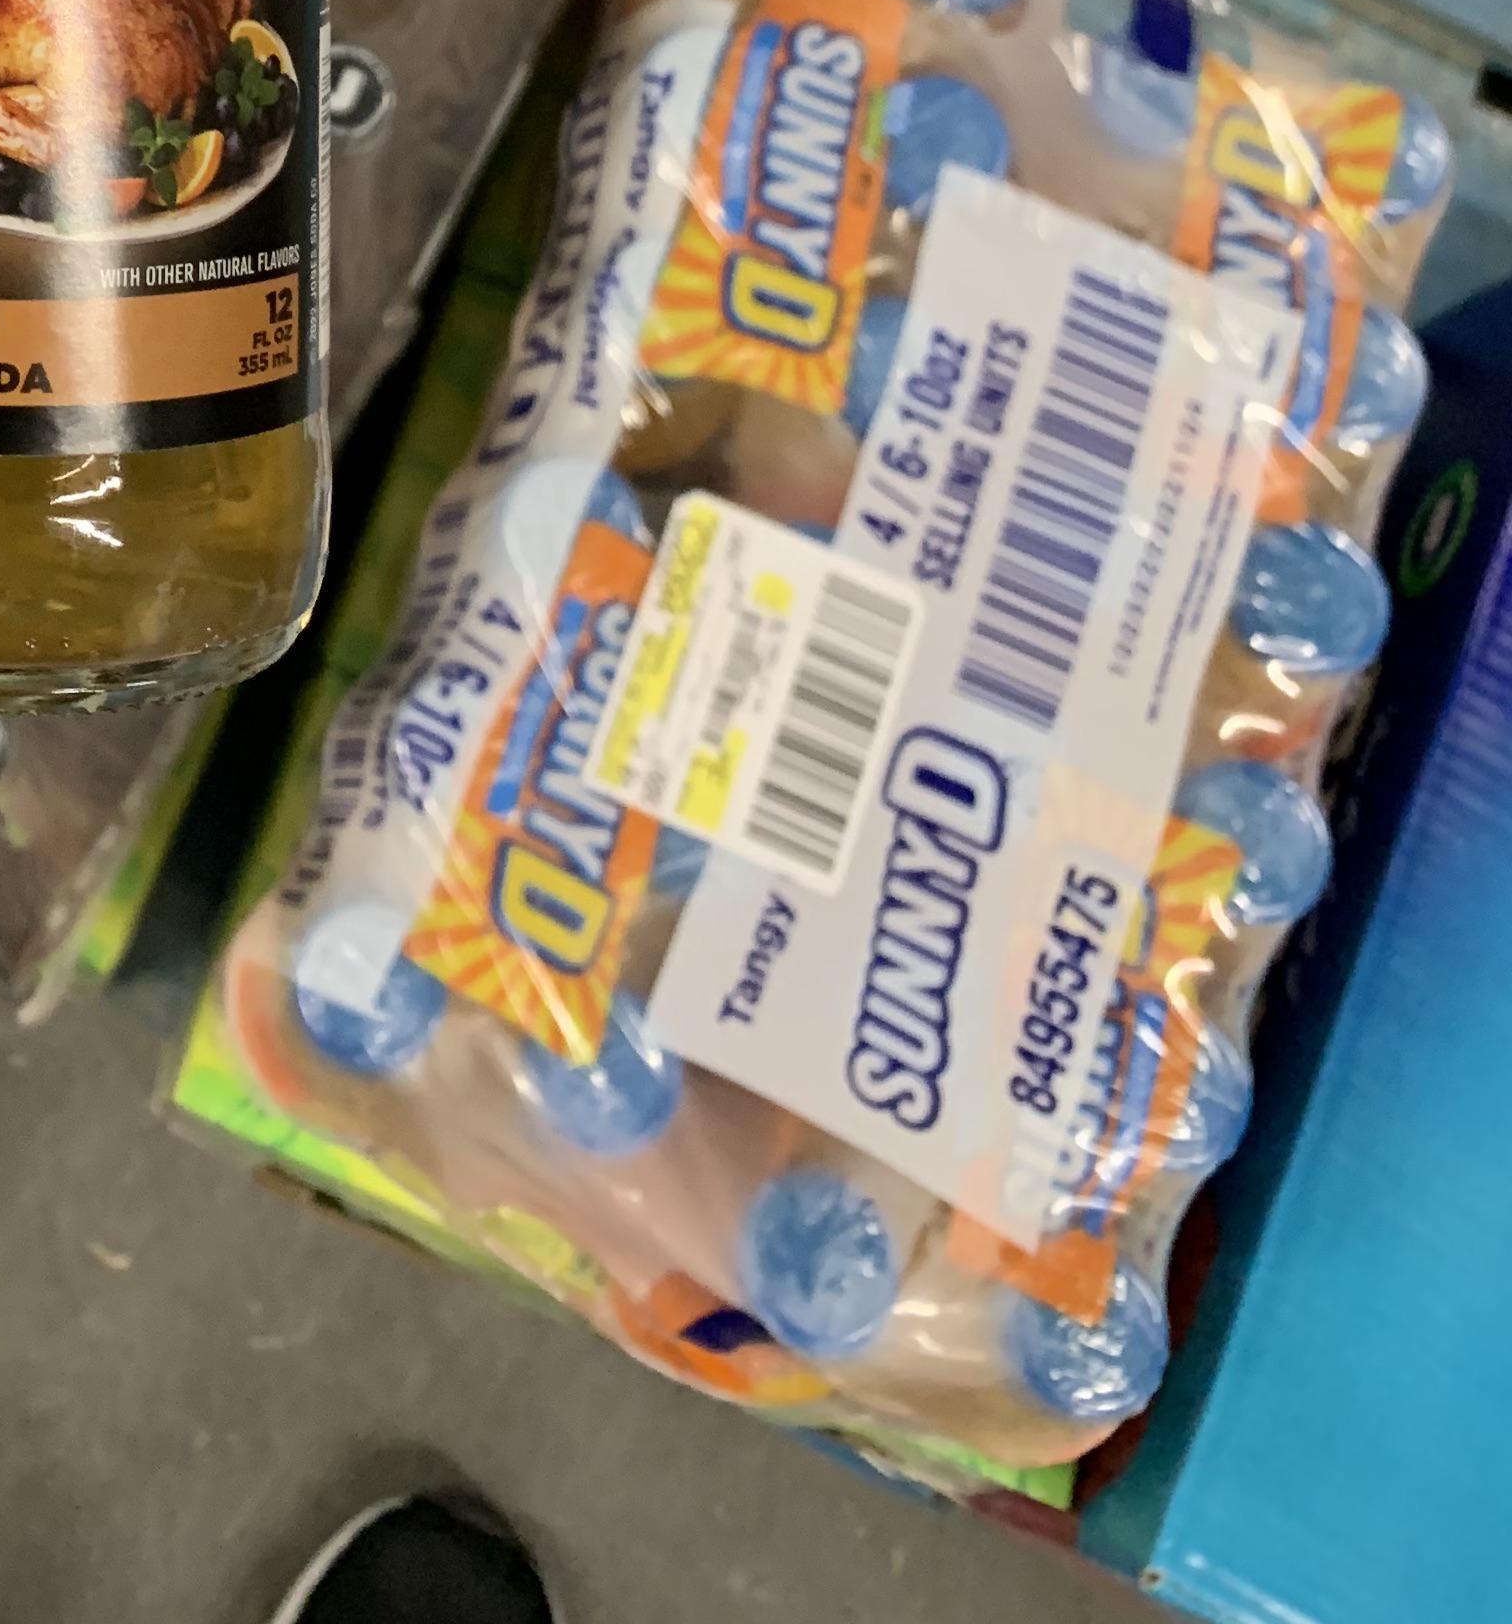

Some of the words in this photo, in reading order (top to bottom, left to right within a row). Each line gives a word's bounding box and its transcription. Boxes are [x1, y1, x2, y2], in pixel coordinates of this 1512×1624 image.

[99, 266, 141, 290] WITH
[145, 262, 194, 287] OTHER
[198, 253, 255, 282] NATURAL
[257, 243, 300, 272] FLAVORS
[264, 286, 293, 324] 12
[252, 330, 271, 350] FL
[273, 324, 293, 345] OZ
[238, 351, 269, 377] 355
[911, 438, 992, 591] SELLING
[718, 890, 800, 1027] Tangy
[1007, 865, 1121, 1116] 84955475
